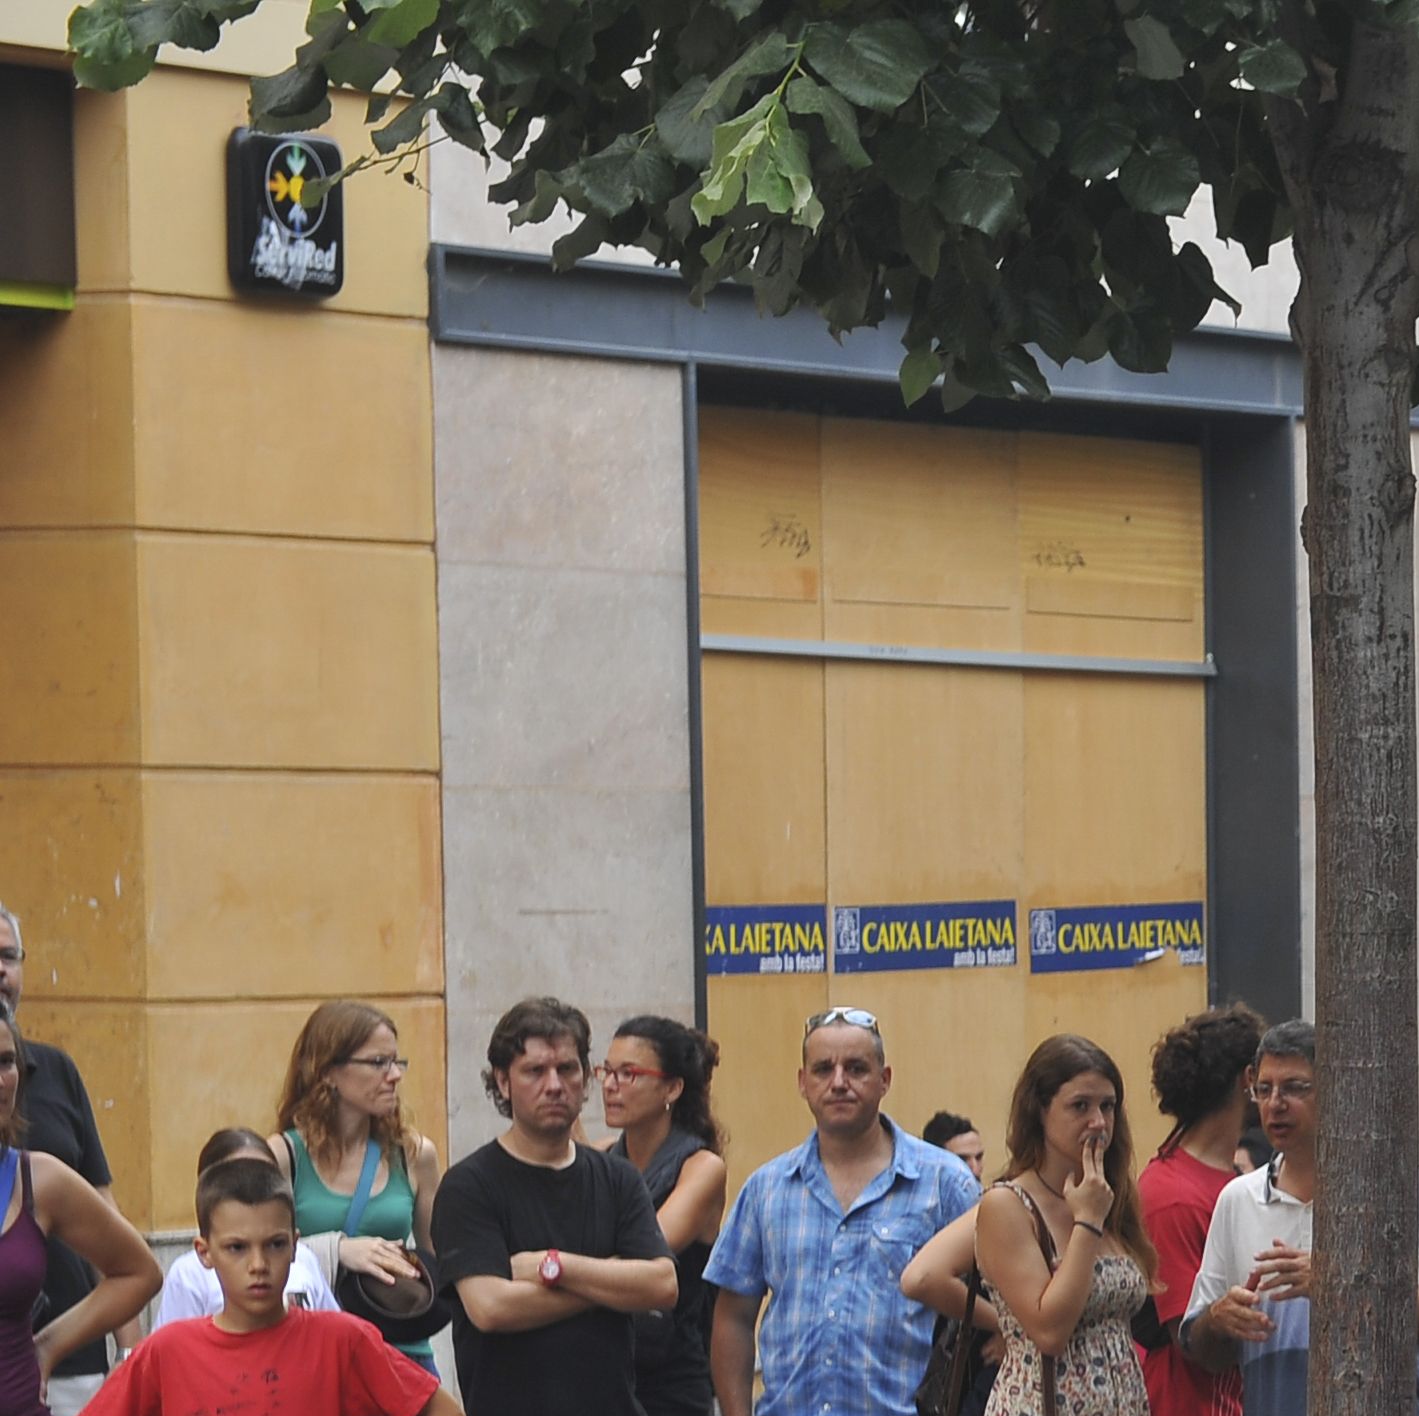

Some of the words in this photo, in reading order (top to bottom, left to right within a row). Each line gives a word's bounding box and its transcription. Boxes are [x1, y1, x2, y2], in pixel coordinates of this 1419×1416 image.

[729, 920, 825, 955] LAIETANA
[862, 920, 923, 954] CAIXA
[925, 915, 1015, 950] LAIETANA
[1058, 921, 1115, 954] CAIXA
[1117, 917, 1203, 950] LAIETANA
[784, 953, 794, 973] la
[977, 948, 986, 967] la
